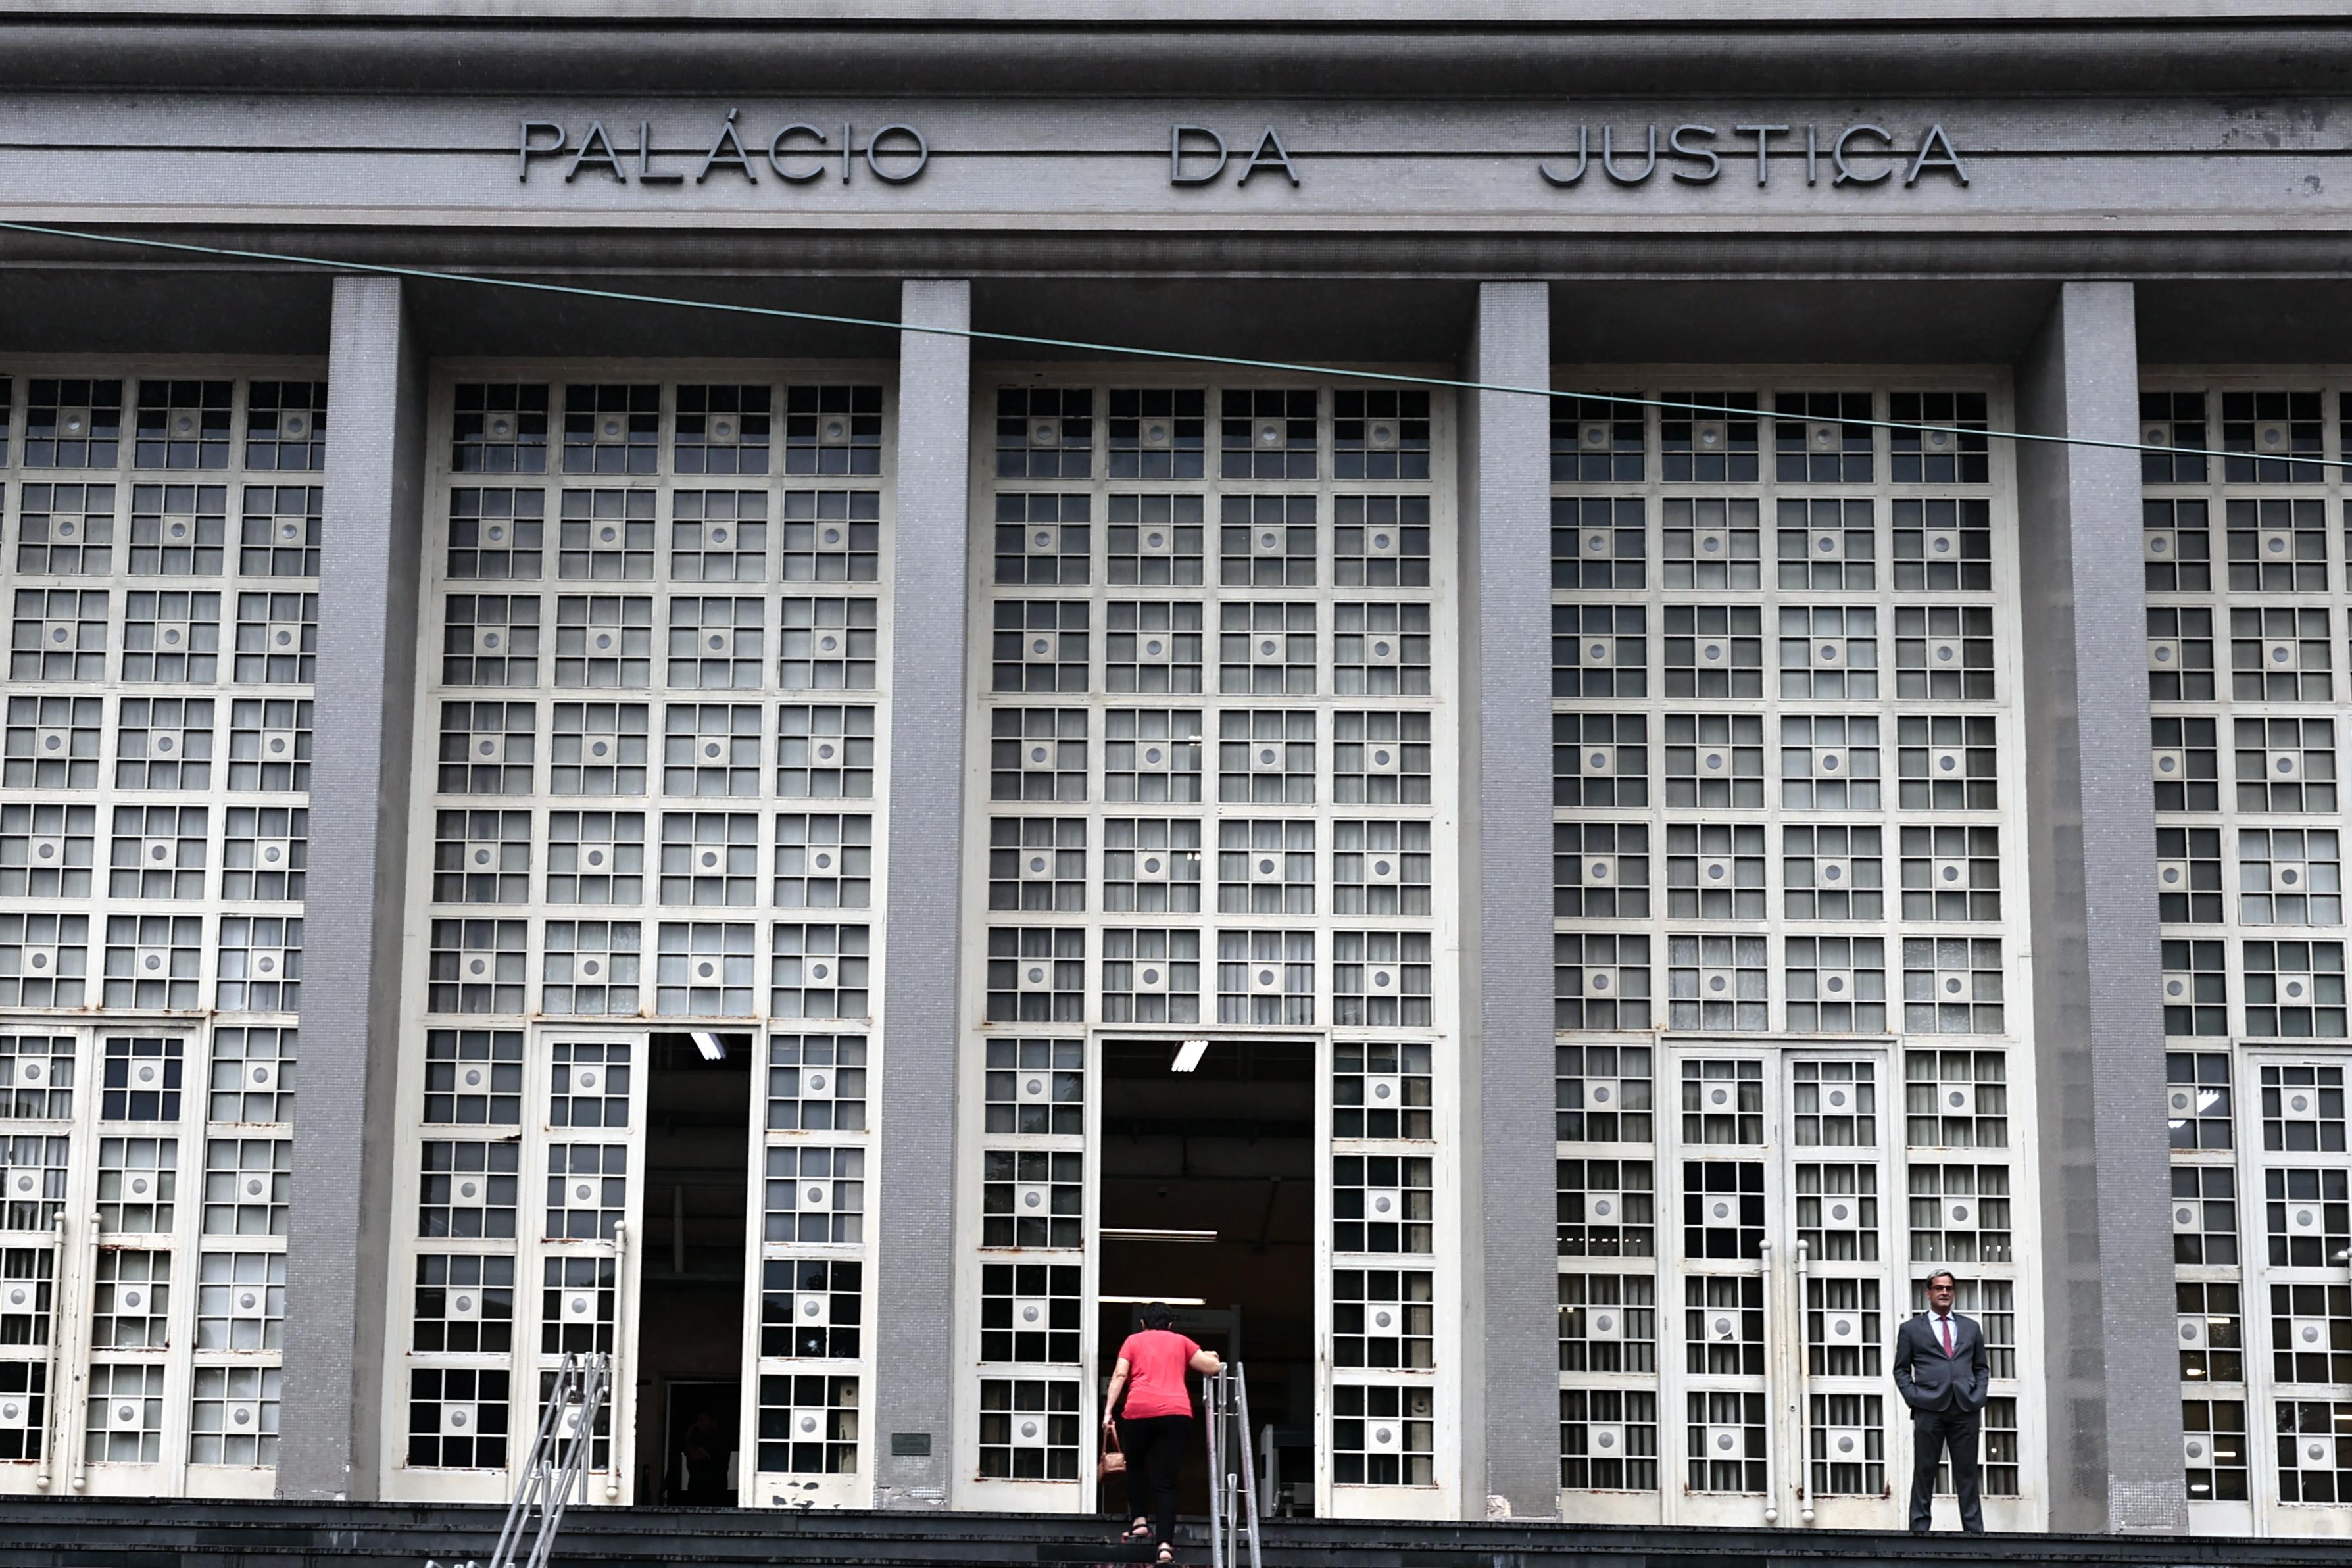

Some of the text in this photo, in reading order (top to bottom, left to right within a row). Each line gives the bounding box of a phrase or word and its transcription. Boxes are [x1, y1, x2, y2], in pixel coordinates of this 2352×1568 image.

[520, 107, 1969, 188] PALÁCIO DA JUSTIÇA
